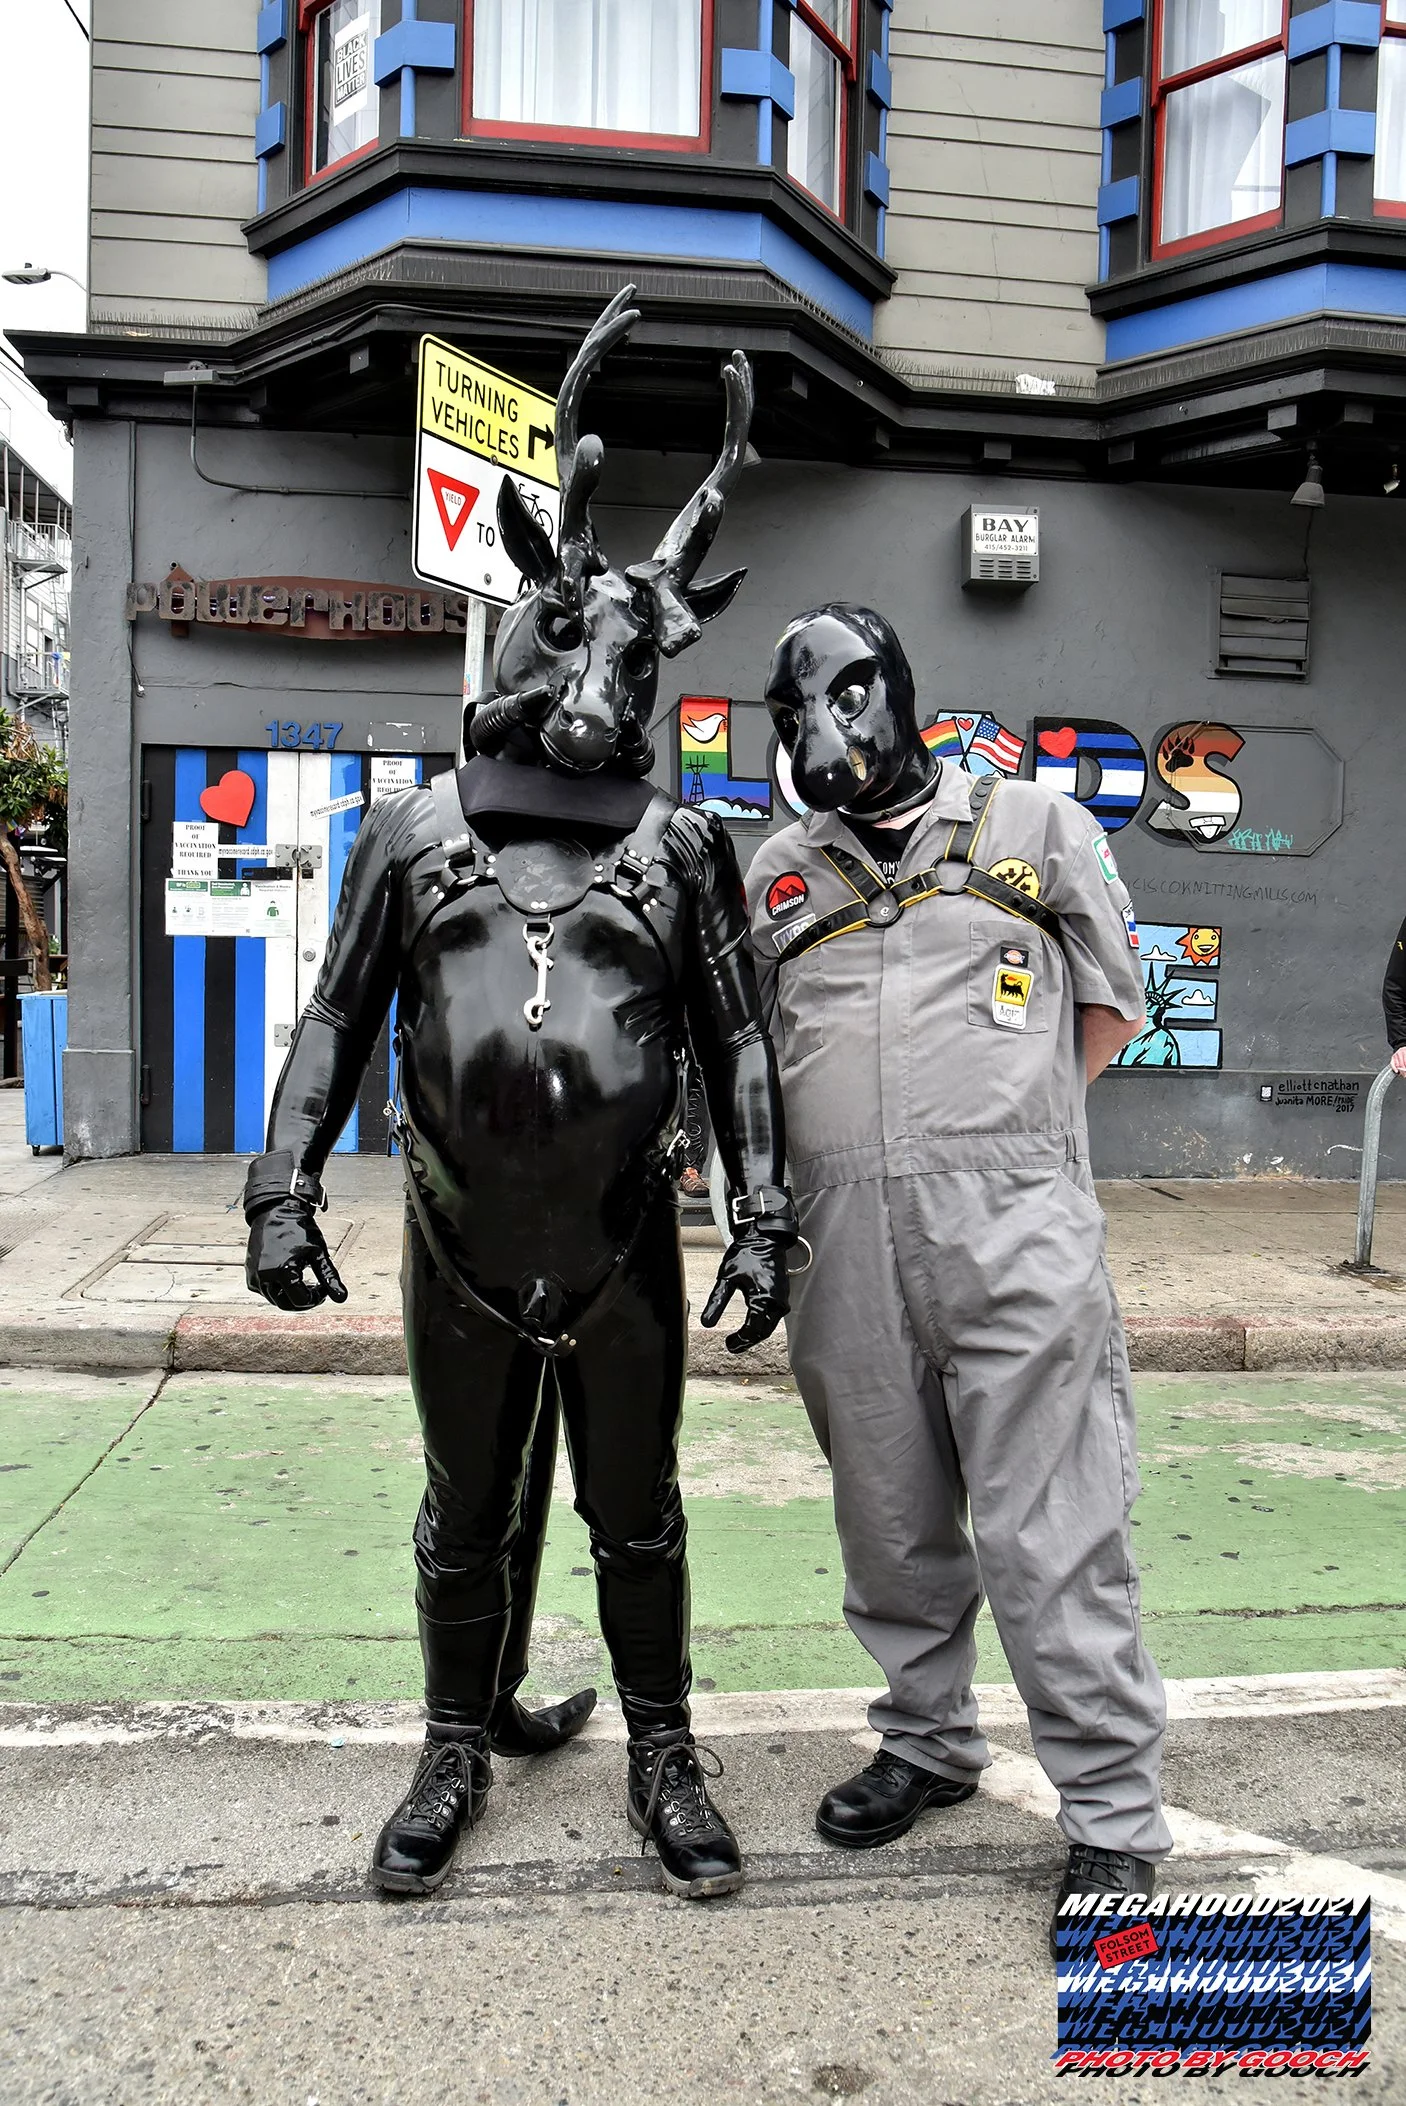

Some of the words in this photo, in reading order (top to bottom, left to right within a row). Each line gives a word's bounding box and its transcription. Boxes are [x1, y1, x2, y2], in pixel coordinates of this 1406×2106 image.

[337, 34, 366, 63] BLACK
[337, 50, 365, 85] LIVES
[337, 73, 366, 102] MATTER
[436, 360, 518, 423] TURNING
[432, 397, 519, 459] VEHICLES
[445, 491, 462, 506] YIELD
[477, 522, 495, 547] TO
[983, 518, 1029, 532] BAY
[976, 533, 1007, 542] BURGLAR
[1011, 535, 1036, 543] ALARM
[984, 544, 1028, 552] 415/452-3211
[265, 719, 343, 749] 1347
[772, 894, 805, 916] CRIMSON
[1336, 1104, 1355, 1112] 2017
